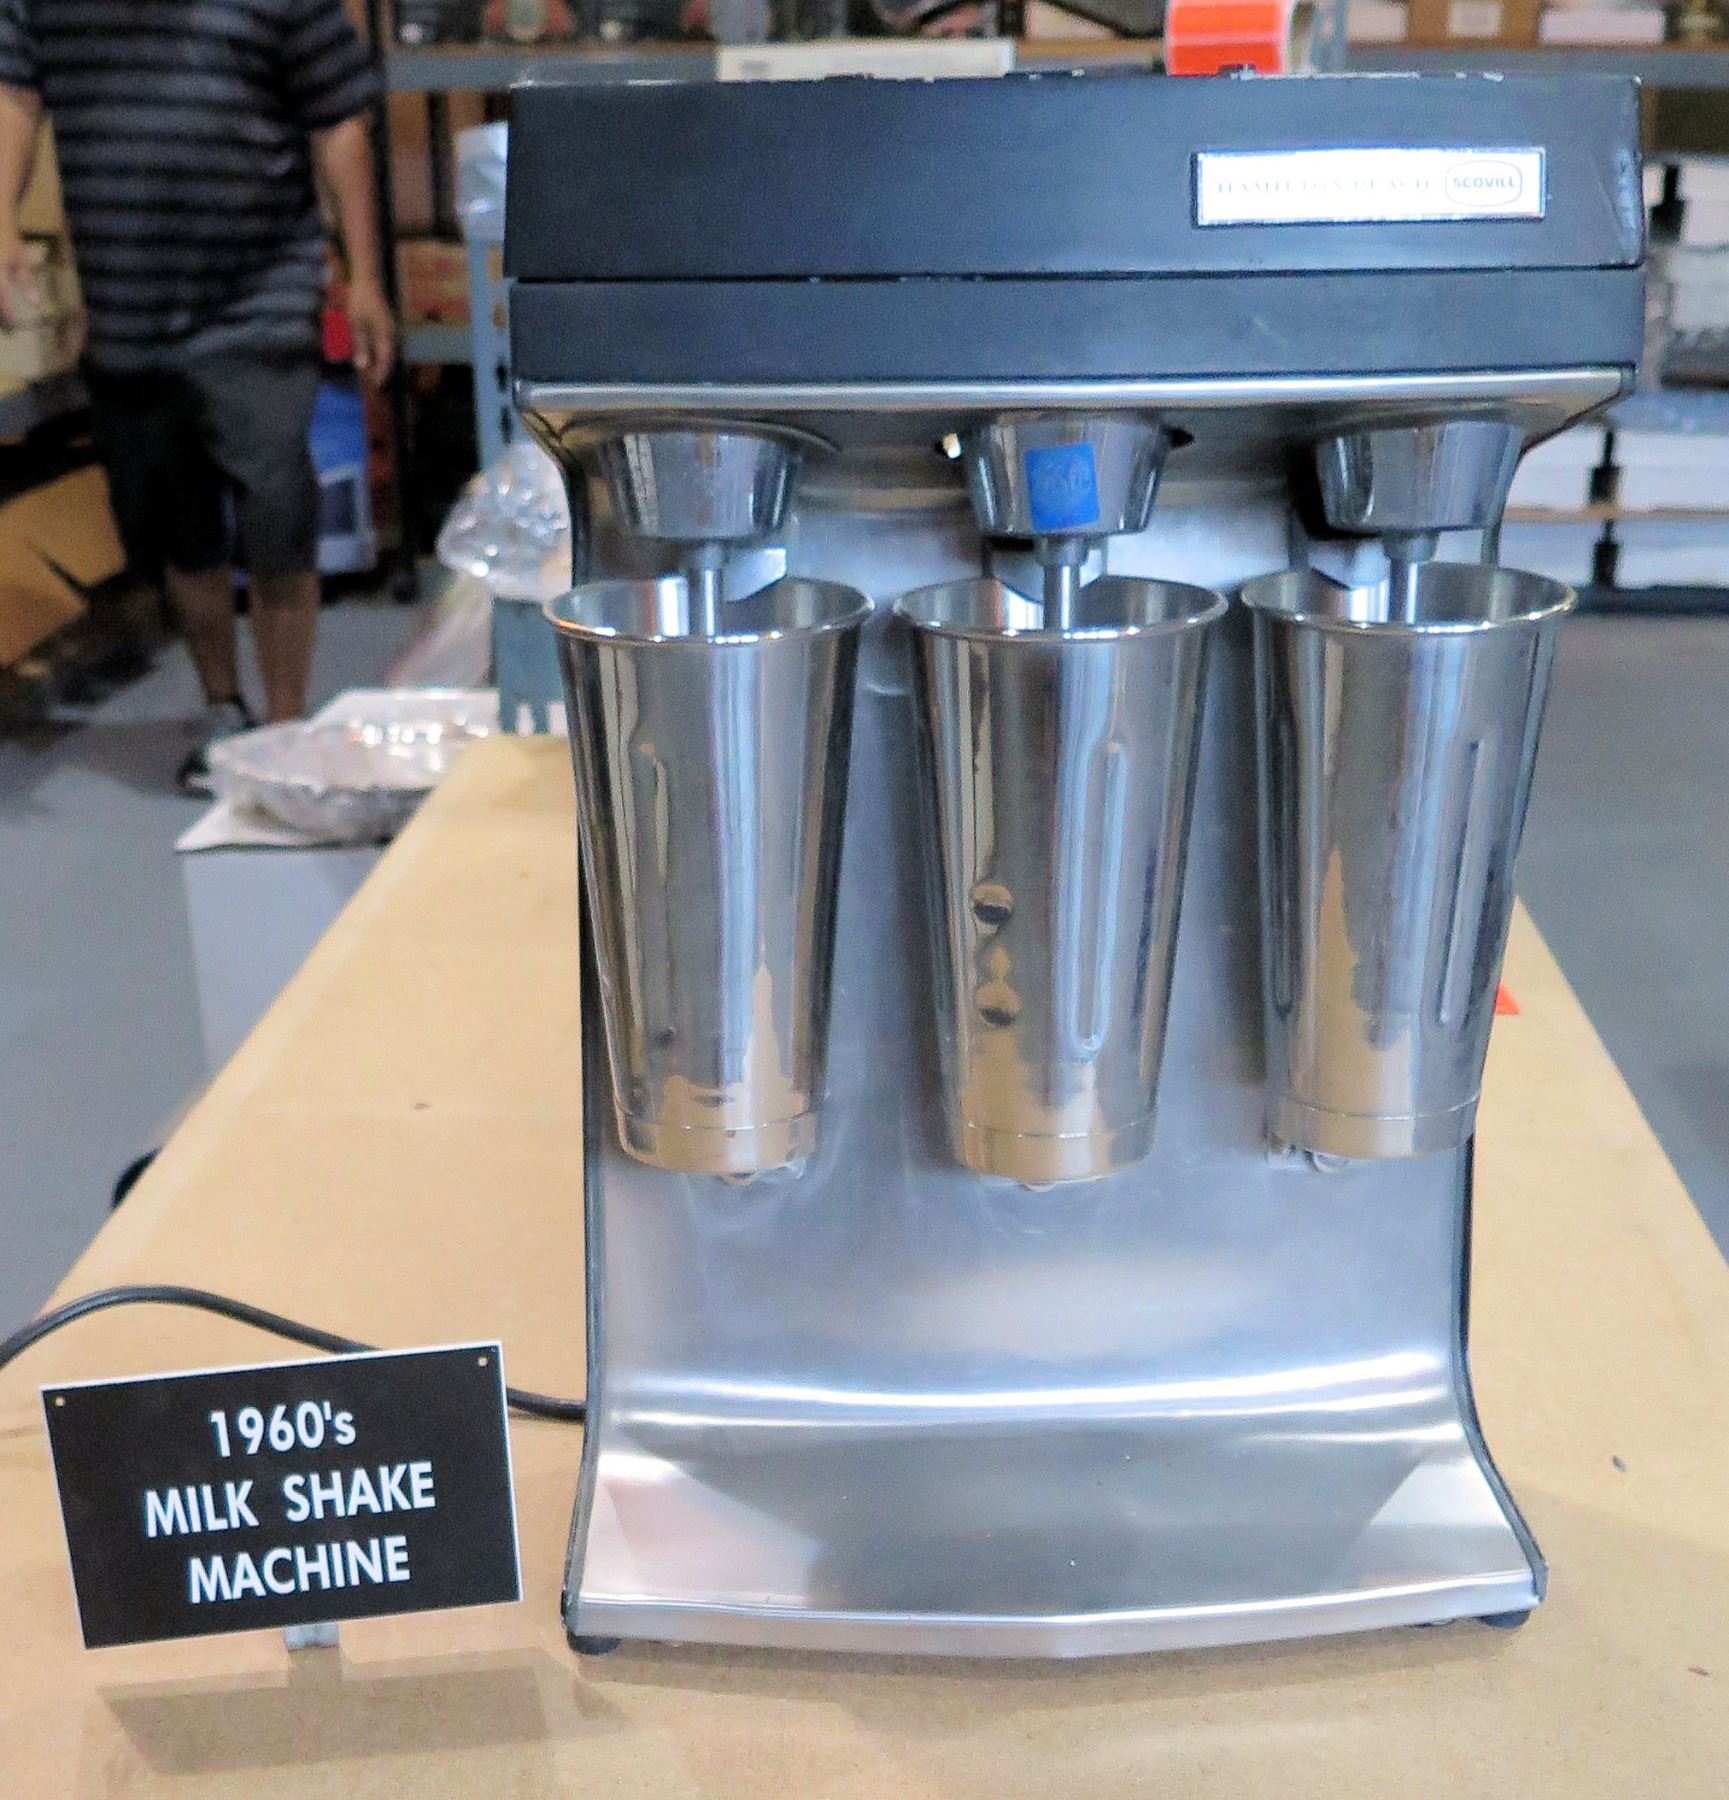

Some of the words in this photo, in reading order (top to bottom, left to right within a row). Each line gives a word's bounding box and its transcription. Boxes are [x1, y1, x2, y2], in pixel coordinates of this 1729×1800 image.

[1452, 175, 1517, 190] SCOVILL
[209, 1400, 357, 1457] 1960's
[145, 1479, 259, 1538] MILK
[282, 1460, 437, 1523] SHAKE
[188, 1535, 411, 1604] MACHINE
